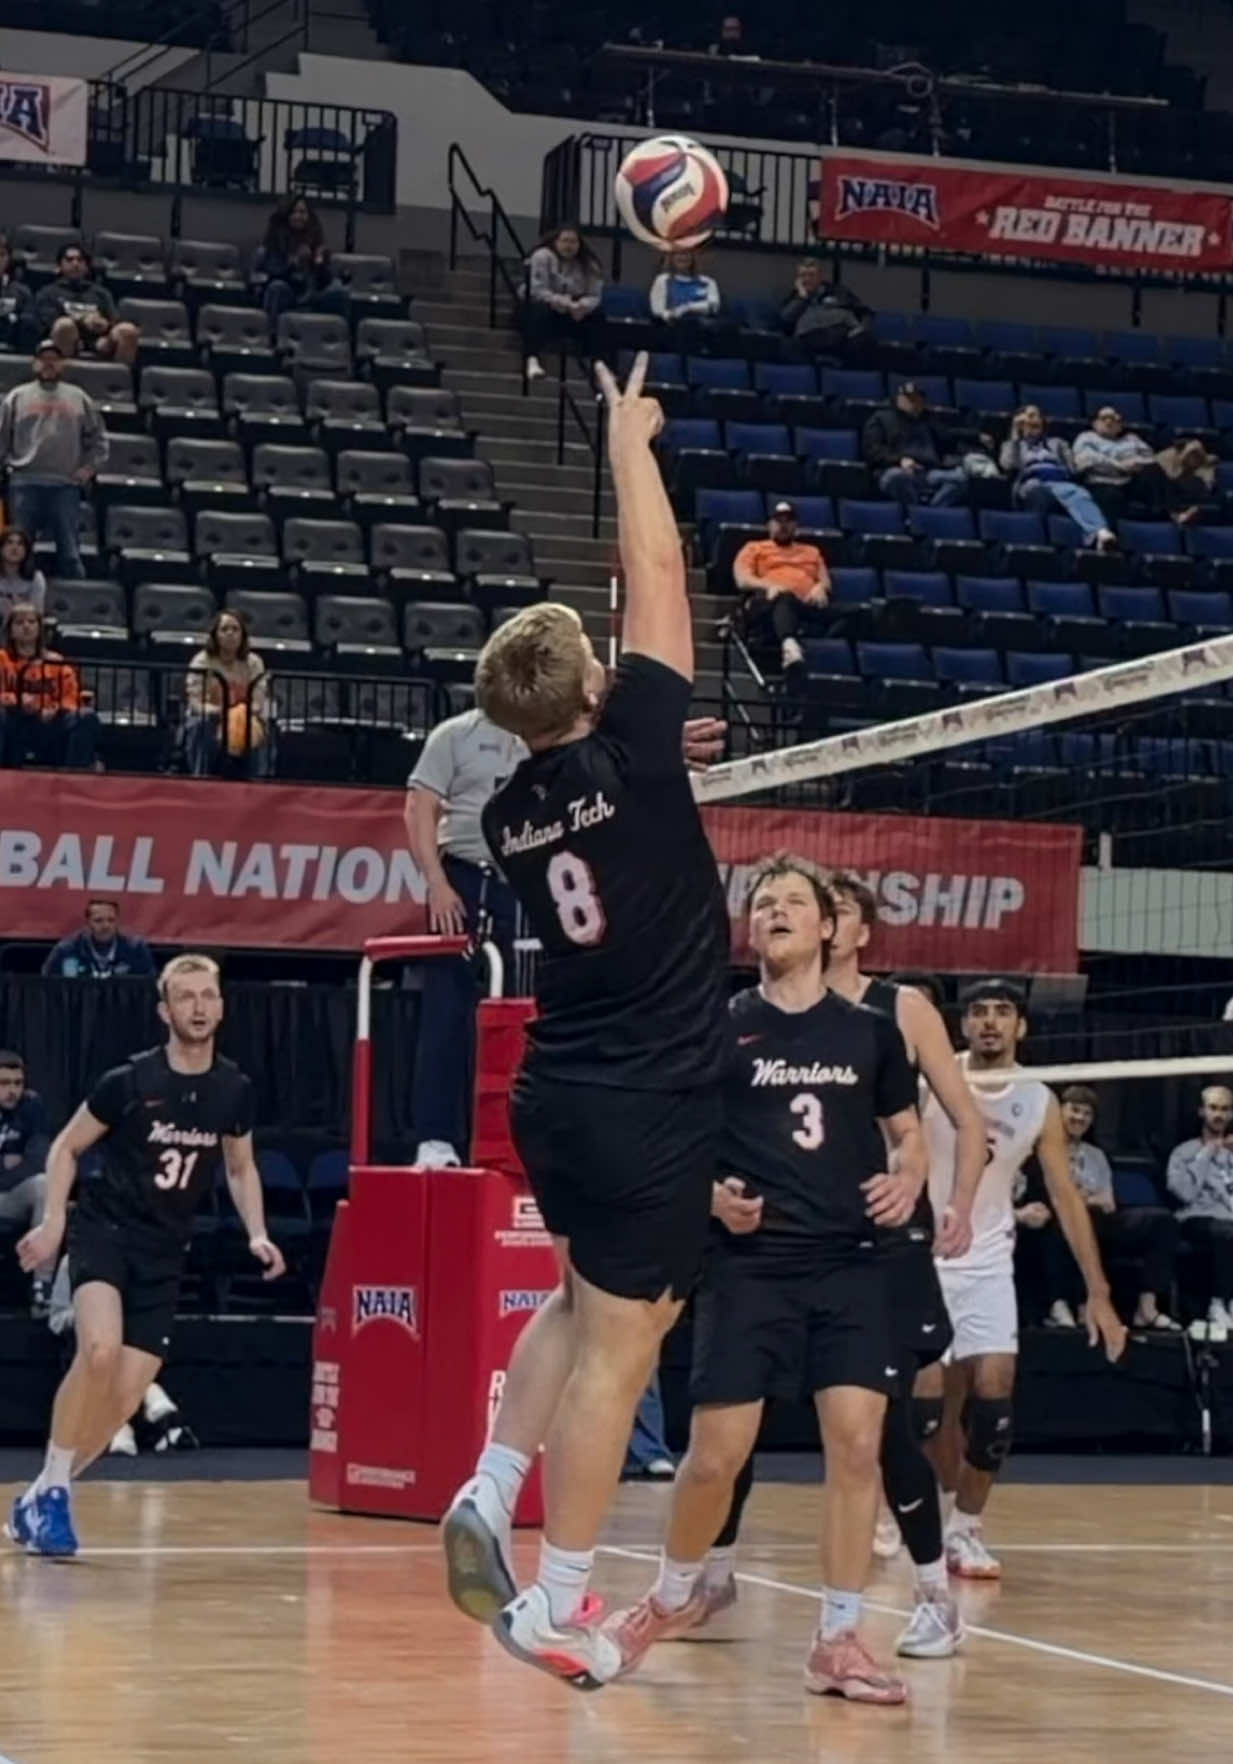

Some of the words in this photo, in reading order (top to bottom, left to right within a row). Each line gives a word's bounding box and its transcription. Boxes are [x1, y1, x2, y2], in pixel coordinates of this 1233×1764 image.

[836, 176, 940, 229] NAIA
[989, 206, 1062, 243] RED
[1061, 213, 1205, 257] BANNER
[501, 820, 564, 856] Indiana
[568, 791, 615, 832] Tech
[0, 830, 164, 894] BALL
[547, 851, 606, 947] 8
[751, 1057, 859, 1087] Warriors
[790, 1092, 824, 1151] 3
[154, 1148, 199, 1190] 31
[353, 1285, 417, 1335] NAIA
